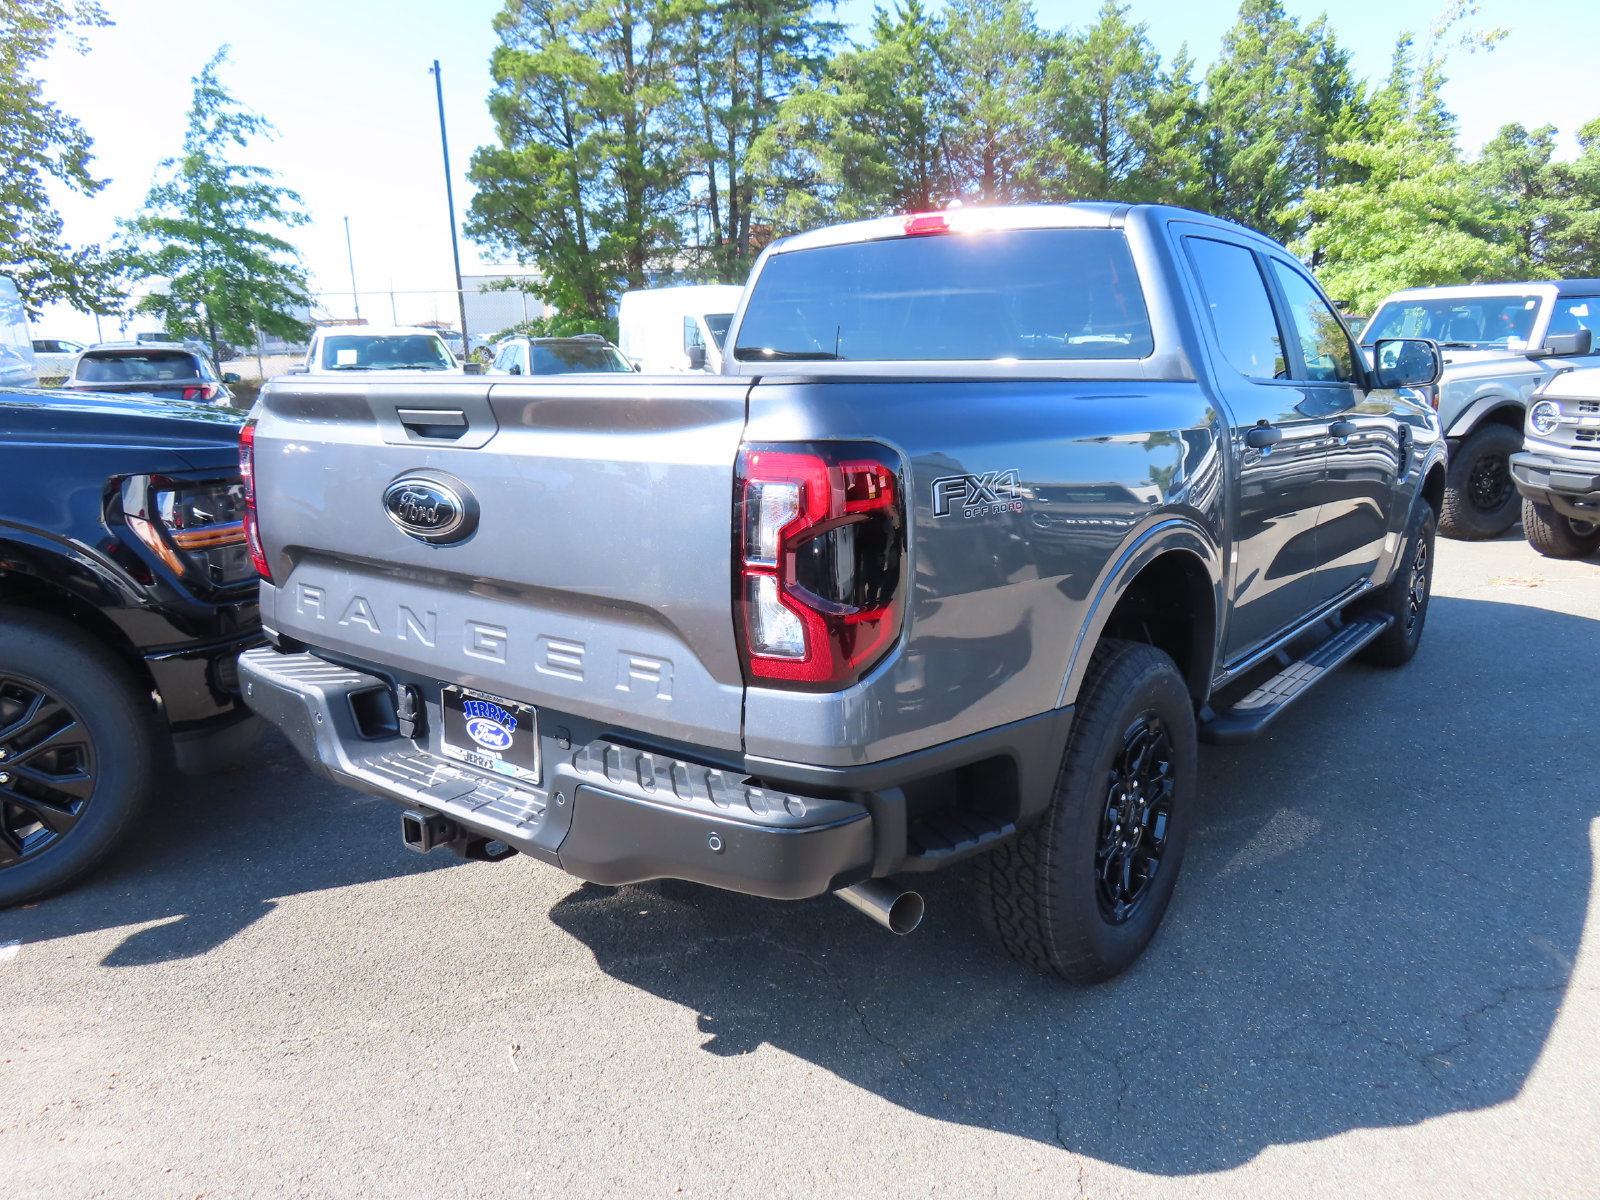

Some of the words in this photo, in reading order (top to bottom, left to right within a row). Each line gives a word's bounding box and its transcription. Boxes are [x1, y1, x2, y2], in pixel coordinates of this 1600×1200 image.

[399, 491, 440, 523] Ford
[931, 468, 1022, 518] FX4
[963, 505, 989, 519] OFF
[992, 501, 1023, 515] ROAD
[296, 583, 675, 701] RANGER
[463, 700, 517, 733] JERRY'S
[474, 722, 504, 747] Ford
[464, 751, 494, 769] JERRY'S
